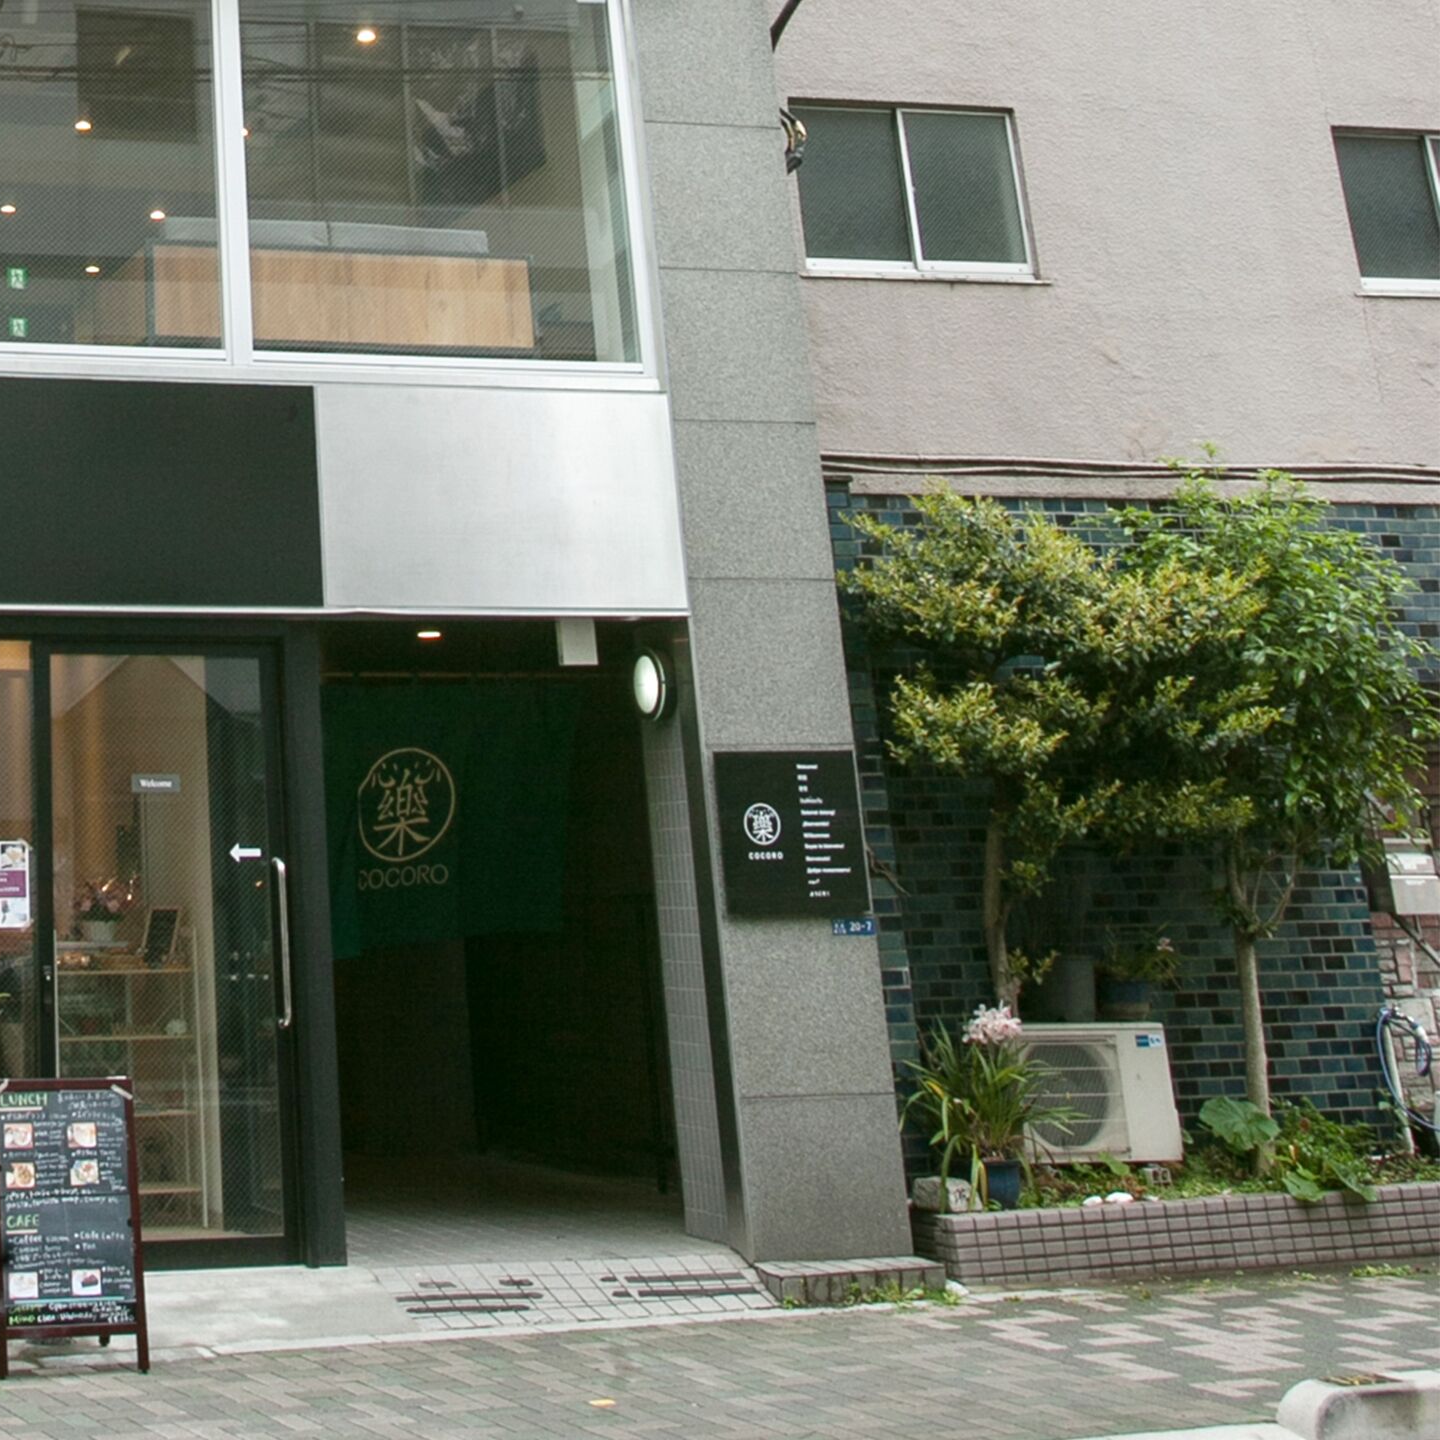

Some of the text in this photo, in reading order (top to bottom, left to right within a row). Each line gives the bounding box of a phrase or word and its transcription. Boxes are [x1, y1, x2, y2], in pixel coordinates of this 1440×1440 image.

[139, 778, 172, 788] Welcome
[748, 851, 784, 860] COCORO
[357, 864, 449, 891] COCORO
[0, 1092, 48, 1107] LUNCH
[6, 1213, 40, 1229] CAFE
